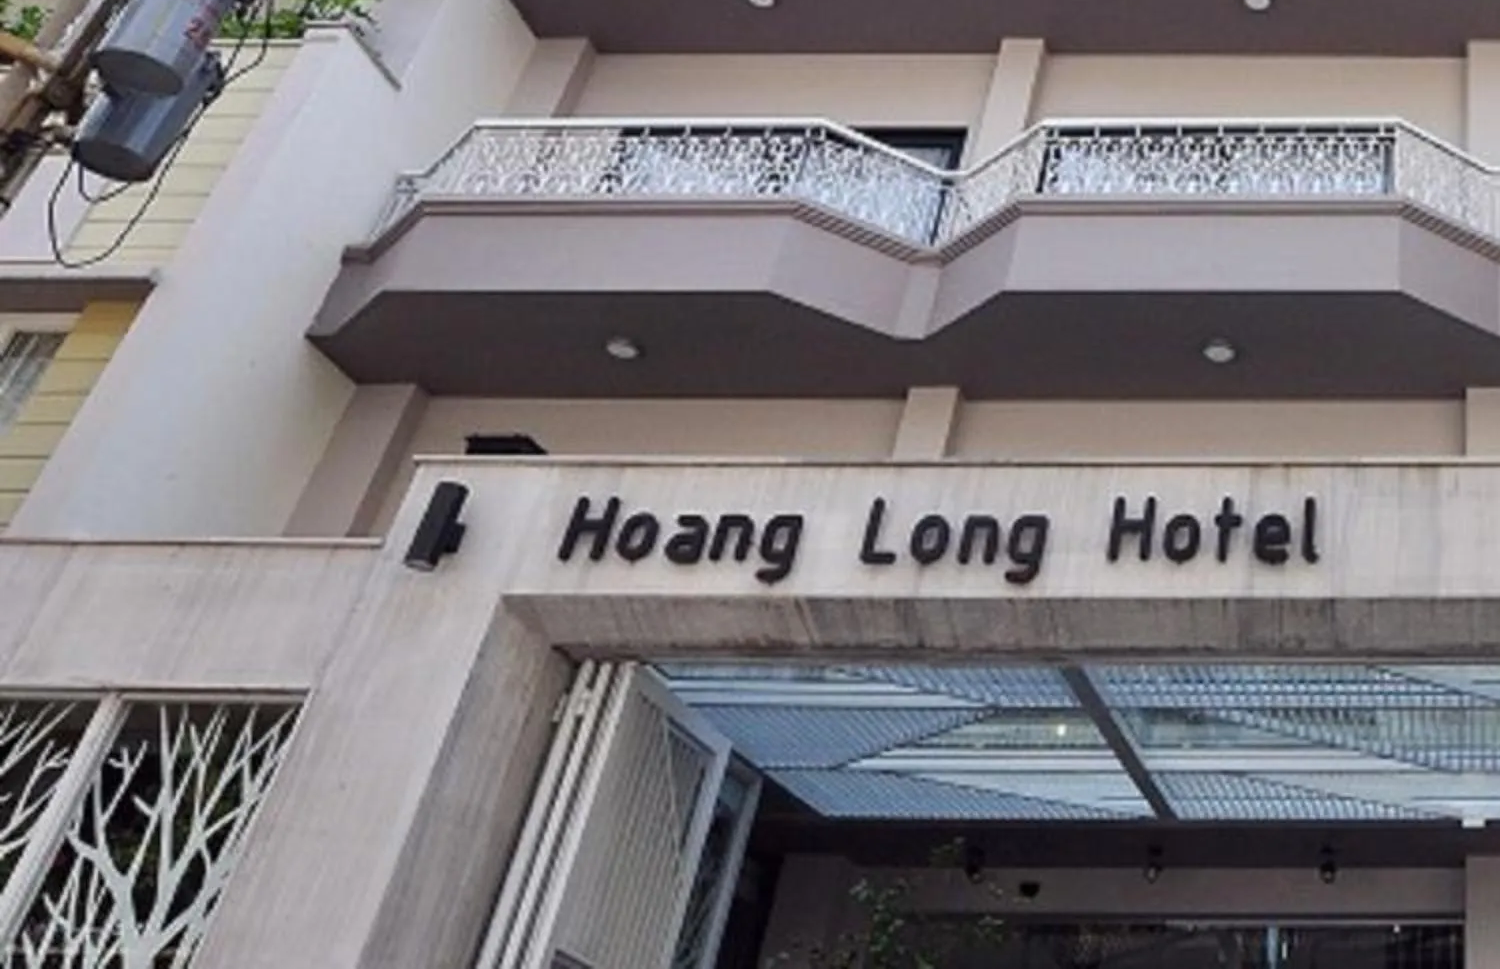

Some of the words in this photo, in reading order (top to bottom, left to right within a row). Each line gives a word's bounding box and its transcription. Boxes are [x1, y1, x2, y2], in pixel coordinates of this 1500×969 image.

[557, 496, 803, 585] Hoang
[859, 497, 1049, 585] Long
[1106, 495, 1320, 565] Hotel
